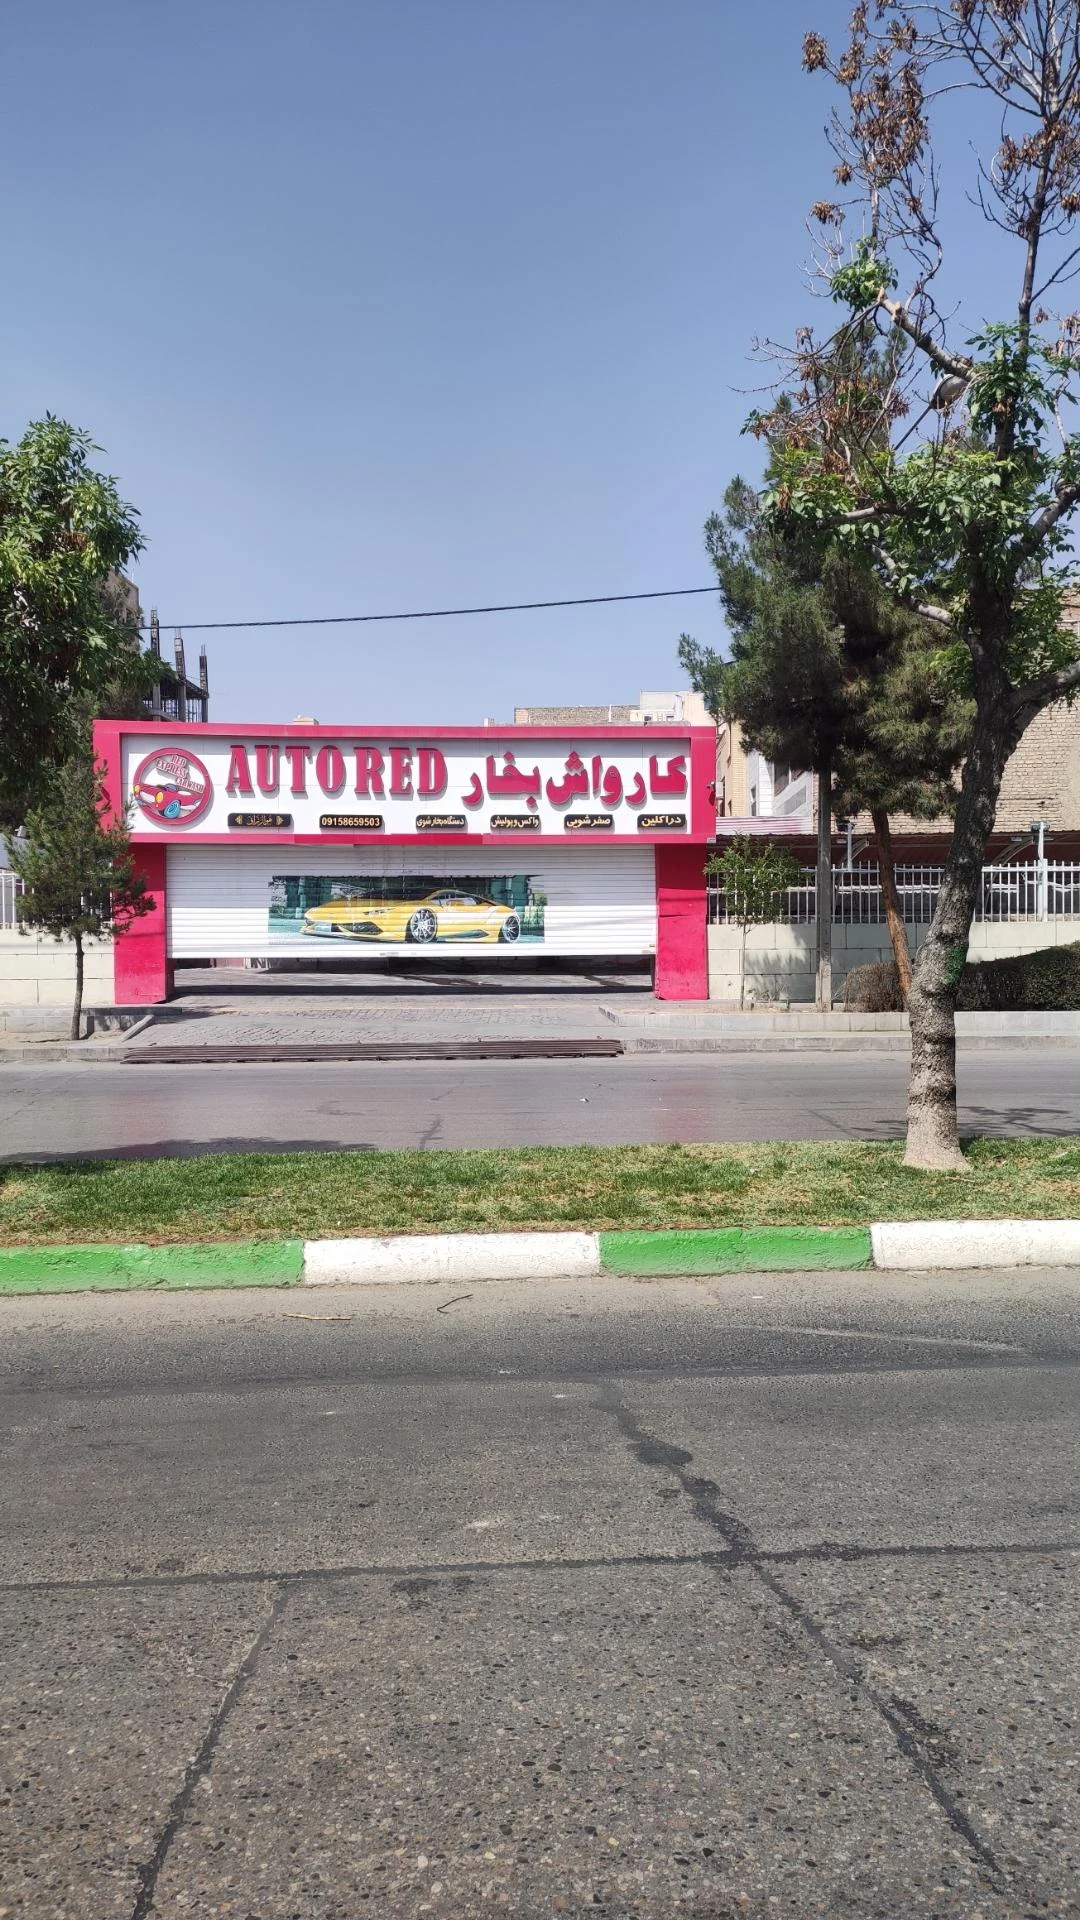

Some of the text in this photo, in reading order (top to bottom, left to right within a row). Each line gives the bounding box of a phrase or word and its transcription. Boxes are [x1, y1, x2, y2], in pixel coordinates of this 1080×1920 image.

[225, 744, 448, 794] AUTO RED
[461, 751, 687, 808] کارواش بخار
[321, 816, 380, 827] 09158659503
[518, 816, 539, 828] واکس
